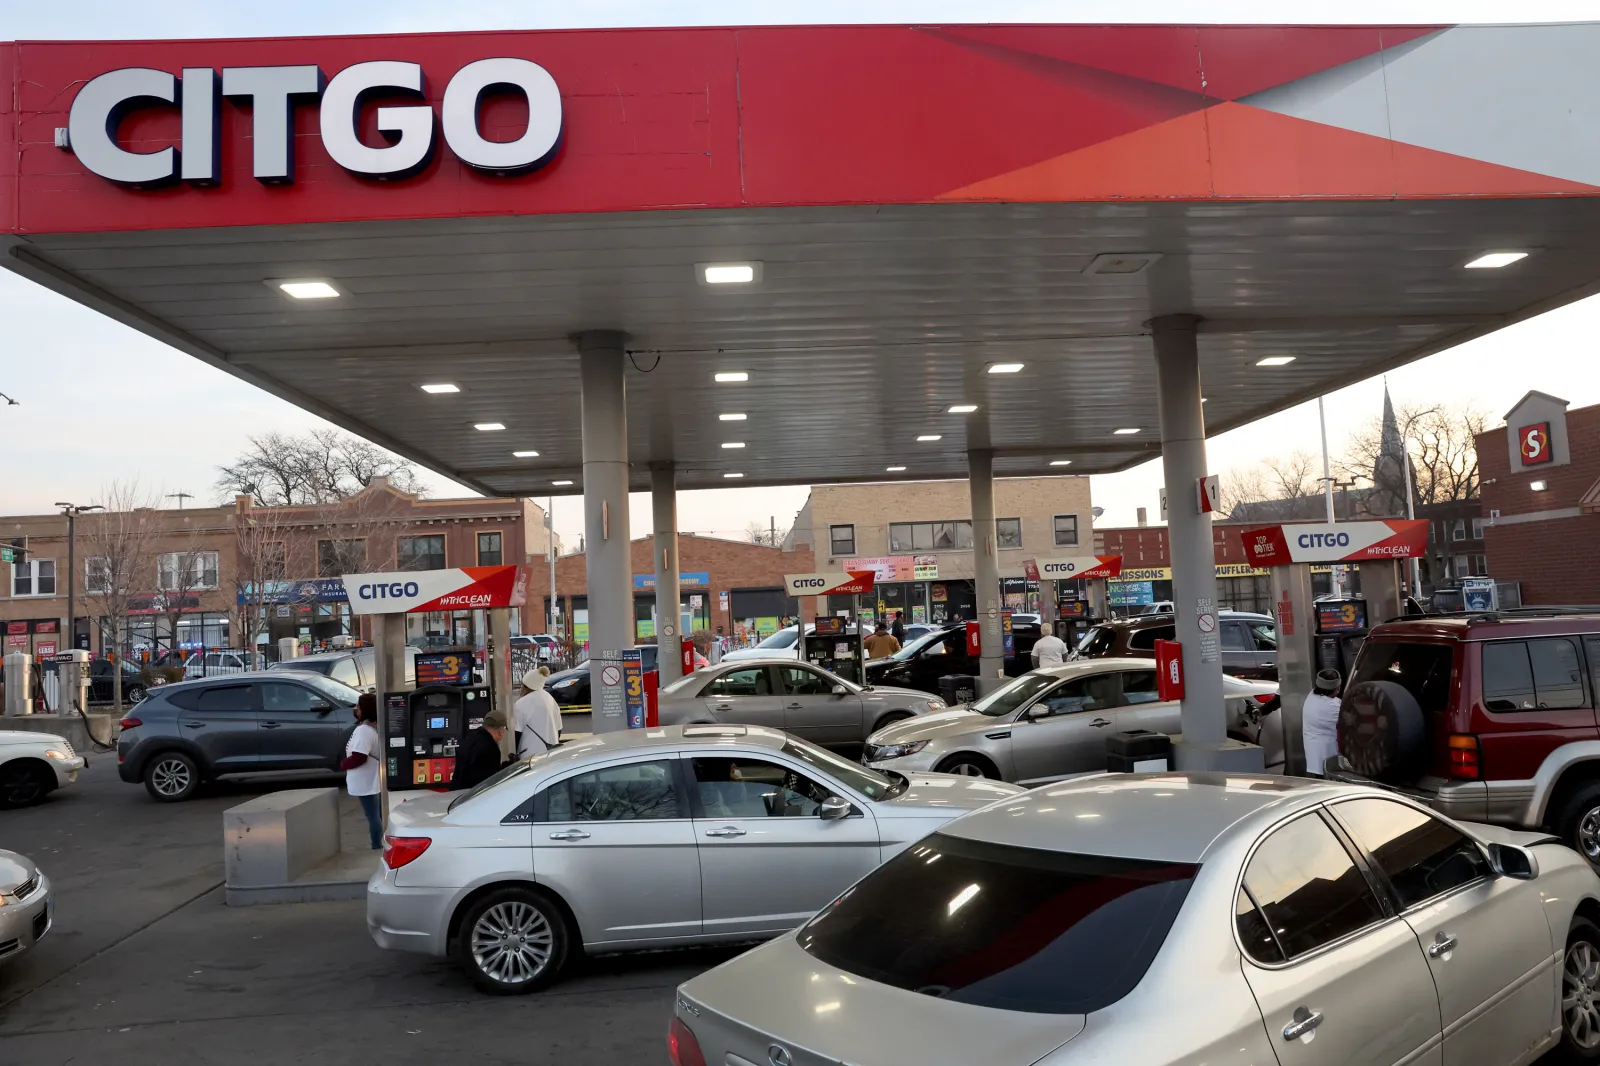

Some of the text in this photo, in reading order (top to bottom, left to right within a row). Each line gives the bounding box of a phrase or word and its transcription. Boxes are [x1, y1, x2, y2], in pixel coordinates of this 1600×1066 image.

[68, 57, 564, 184] CITGO
[1527, 429, 1541, 459] S
[1211, 485, 1216, 500] 1
[1162, 497, 1167, 510] 2
[1255, 535, 1267, 544] TOP
[1298, 532, 1350, 548] CITGO
[1261, 543, 1275, 552] TIER
[1044, 563, 1075, 572] CITGO
[793, 578, 825, 588] CITGO
[359, 581, 419, 600] CITGO
[1198, 598, 1212, 606] SELF
[1074, 602, 1082, 613] 3
[830, 618, 840, 629] 3
[38, 646, 55, 655] LEASE
[602, 650, 618, 658] SELF
[600, 658, 621, 667] SERVE
